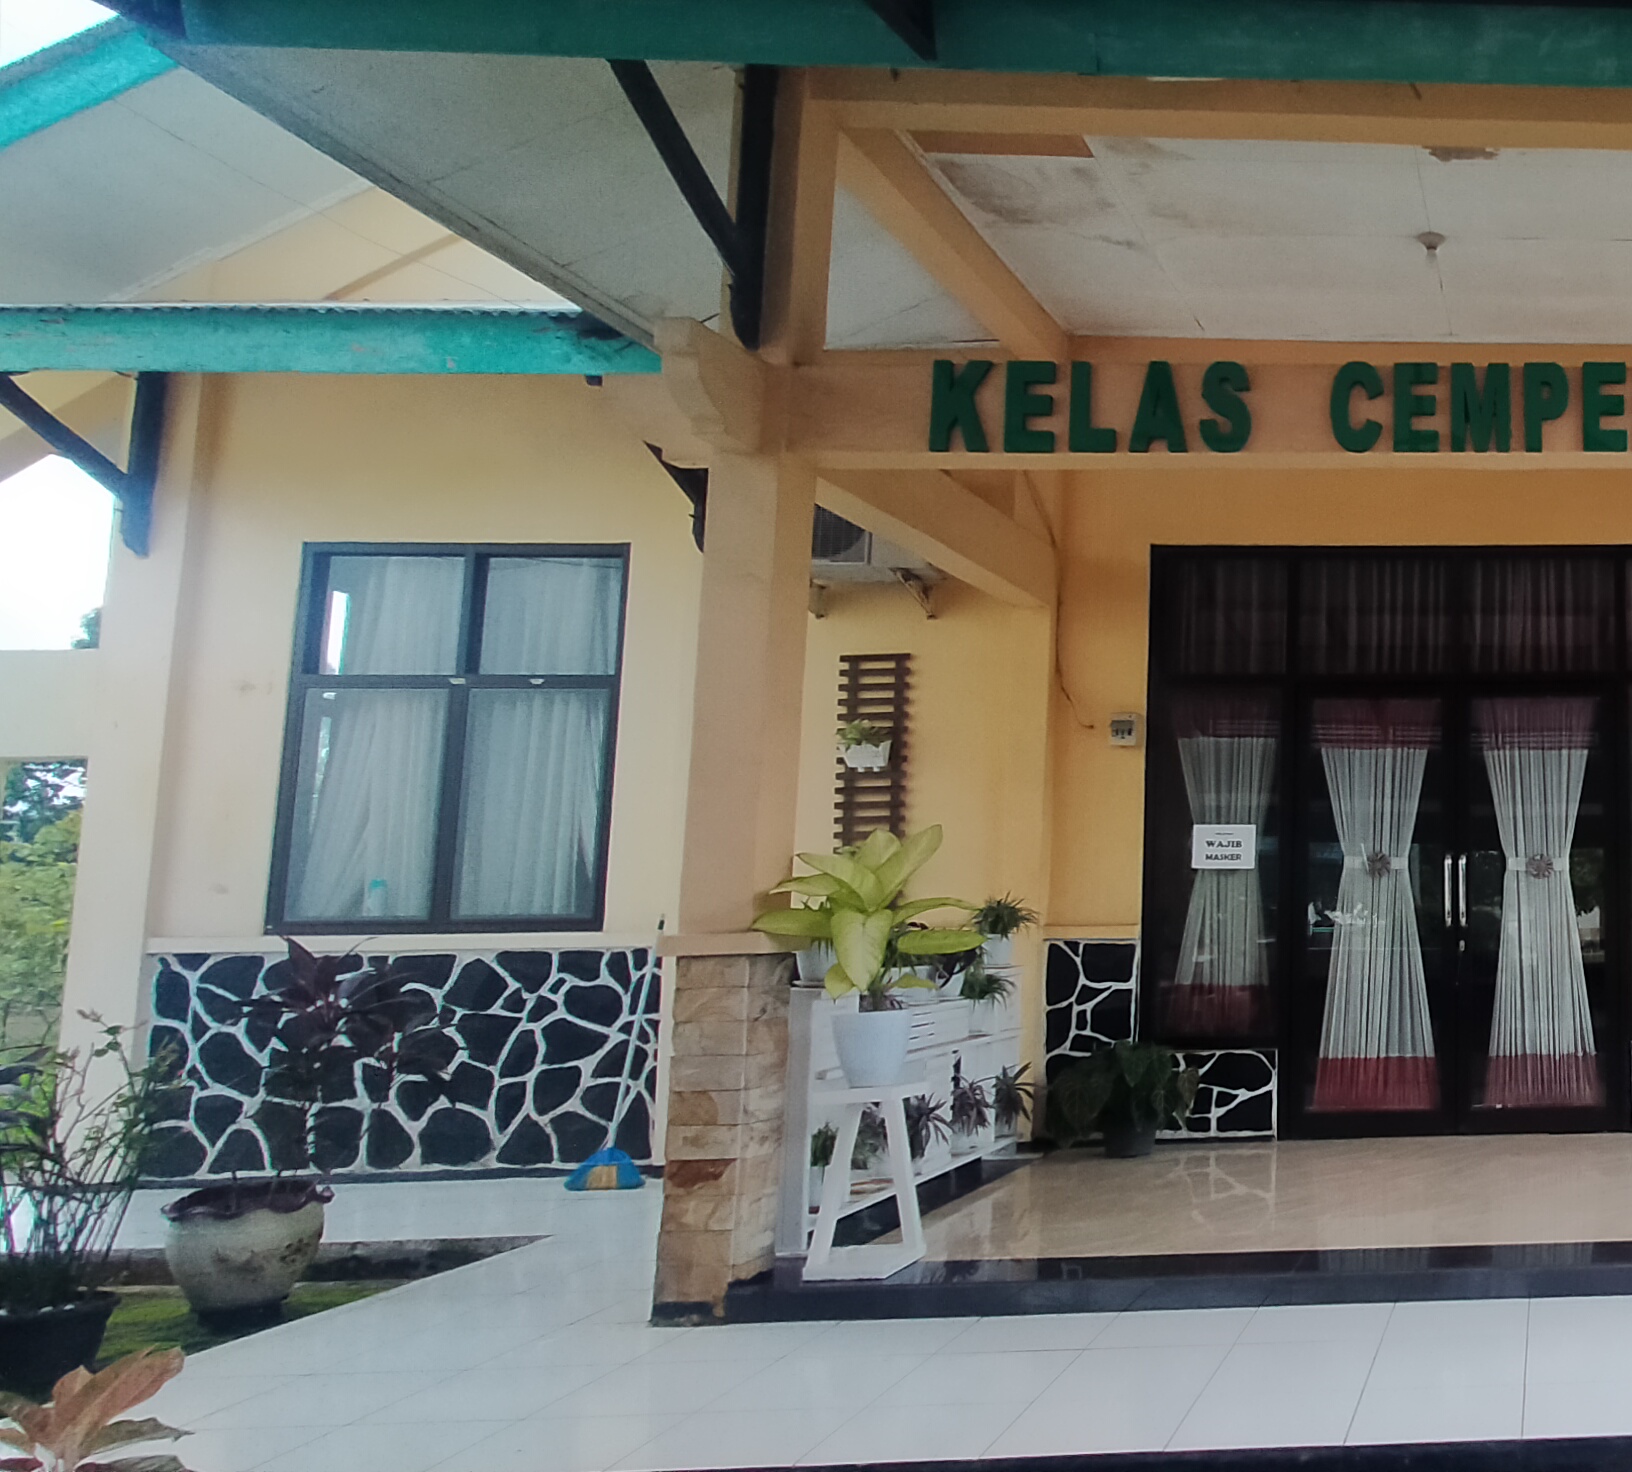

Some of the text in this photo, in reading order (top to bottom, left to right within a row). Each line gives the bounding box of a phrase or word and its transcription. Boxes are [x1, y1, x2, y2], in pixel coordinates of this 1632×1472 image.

[927, 359, 1252, 454] KELAS
[1205, 840, 1243, 848] WAJIB
[1205, 853, 1242, 861] MASKER
